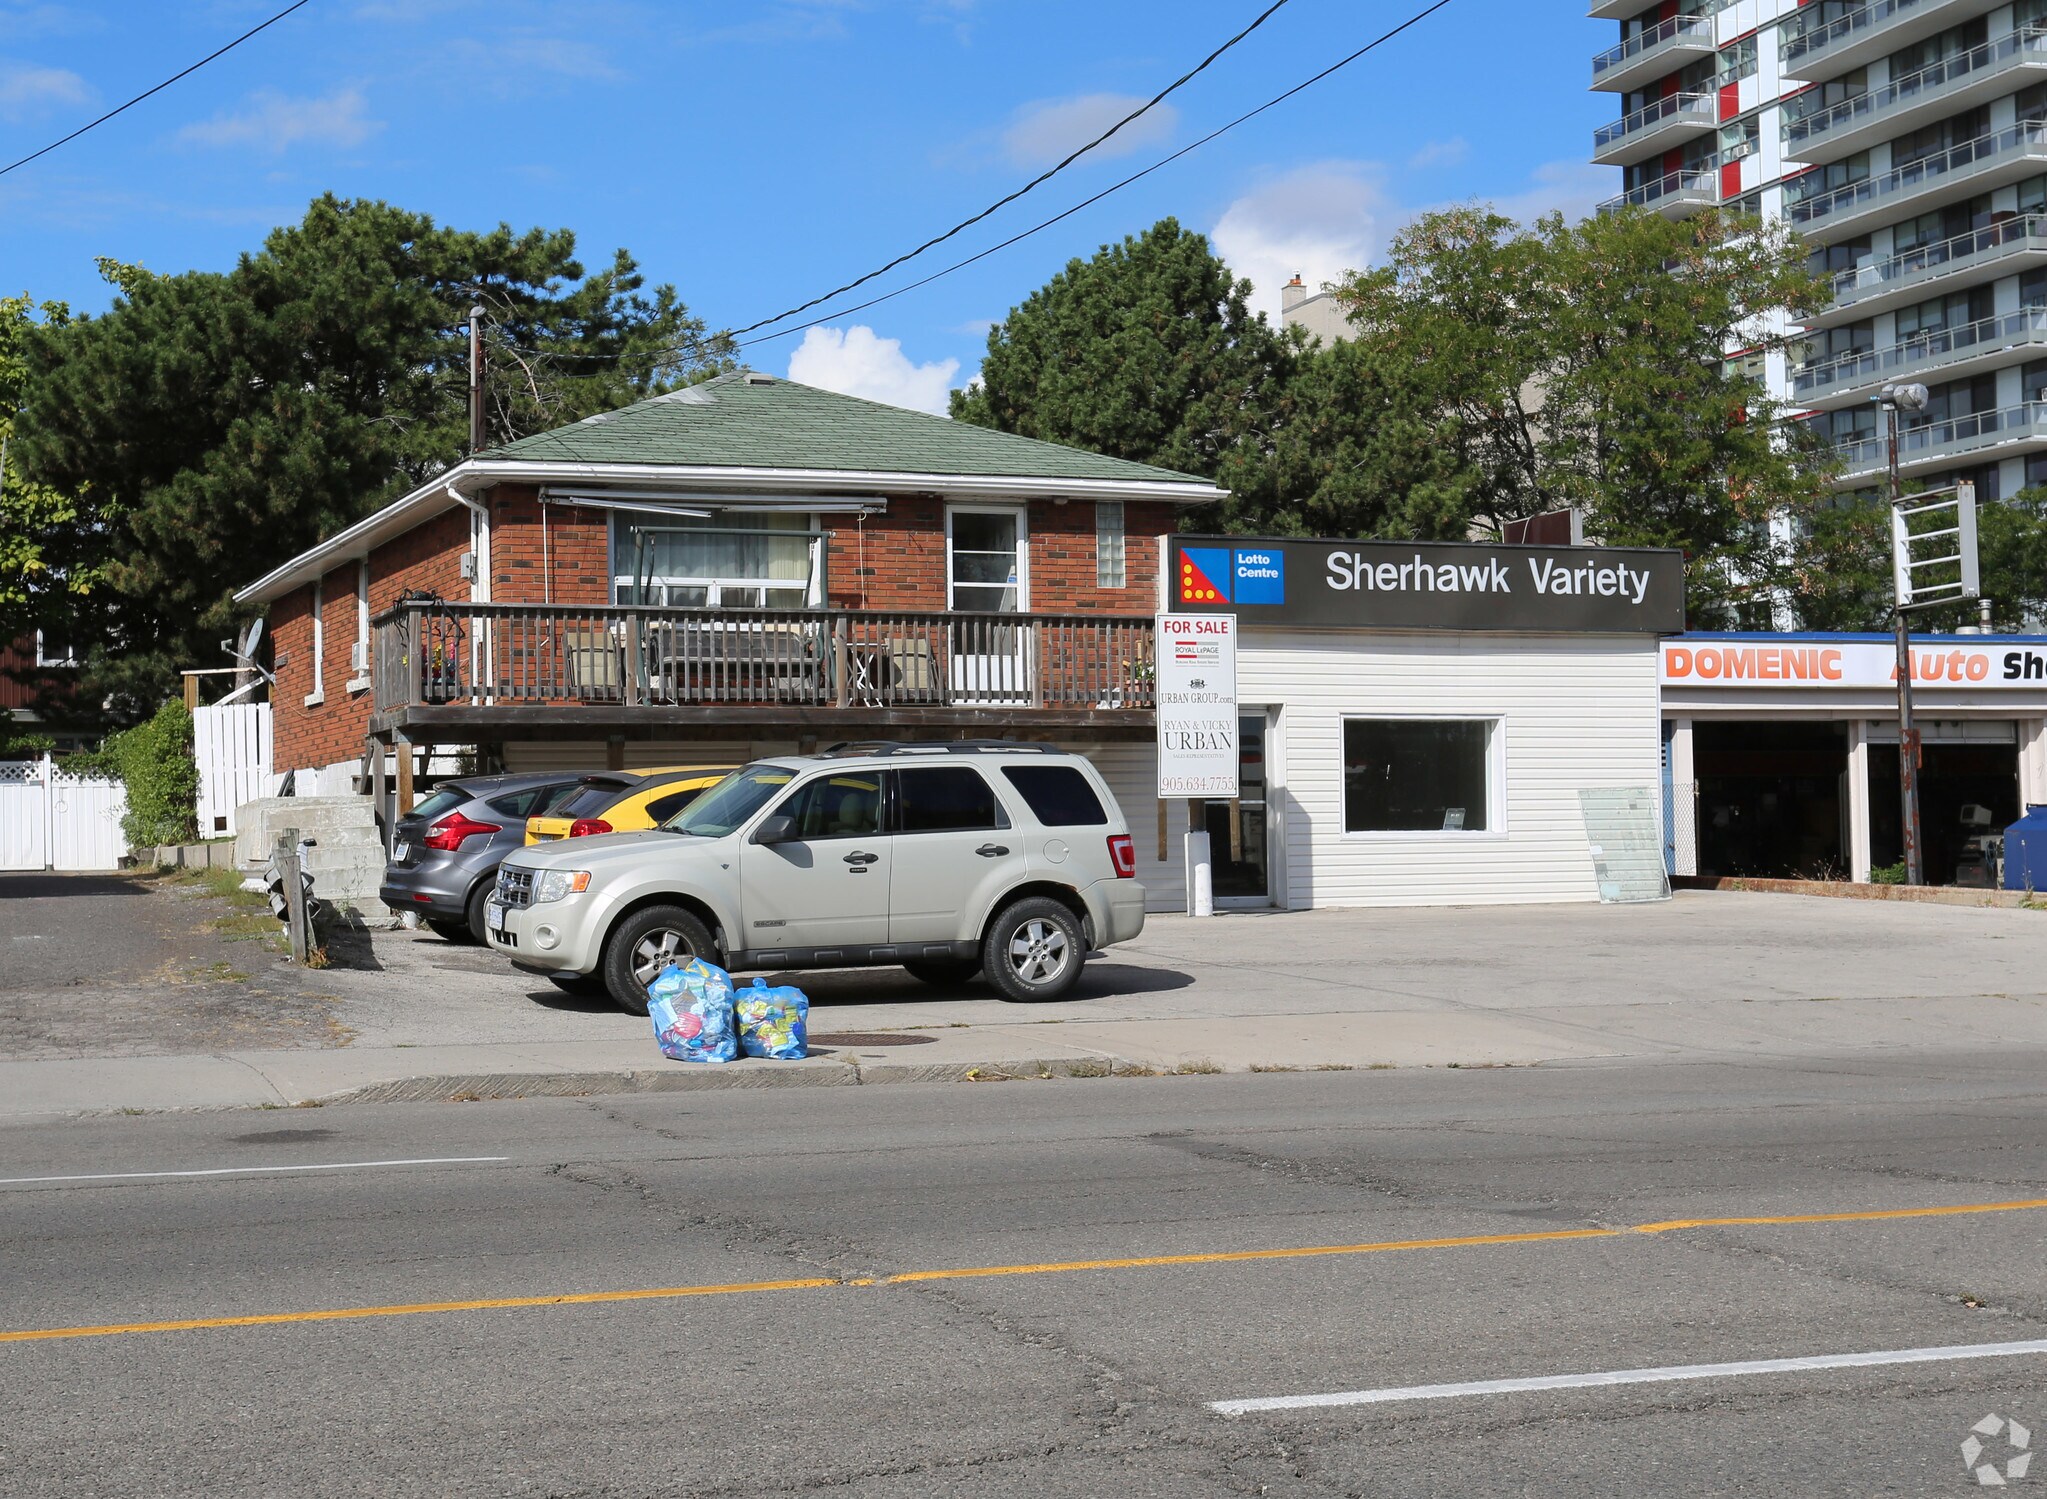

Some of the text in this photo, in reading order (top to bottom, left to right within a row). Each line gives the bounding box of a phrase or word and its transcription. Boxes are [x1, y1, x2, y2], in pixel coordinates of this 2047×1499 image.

[1238, 553, 1270, 565] Lotto
[1237, 566, 1279, 578] Centre
[1326, 551, 1650, 604] Sherhawk Variety
[1164, 621, 1229, 634] FOR SALE
[1665, 648, 1842, 680] DOMENIC
[2003, 651, 2047, 680] Sh
[1161, 692, 1234, 704] URBAN GROUP.com
[1164, 720, 1232, 730] RYAN & VICKY
[1164, 731, 1232, 750] URBAN
[1162, 777, 1234, 791] 905.634.7755
